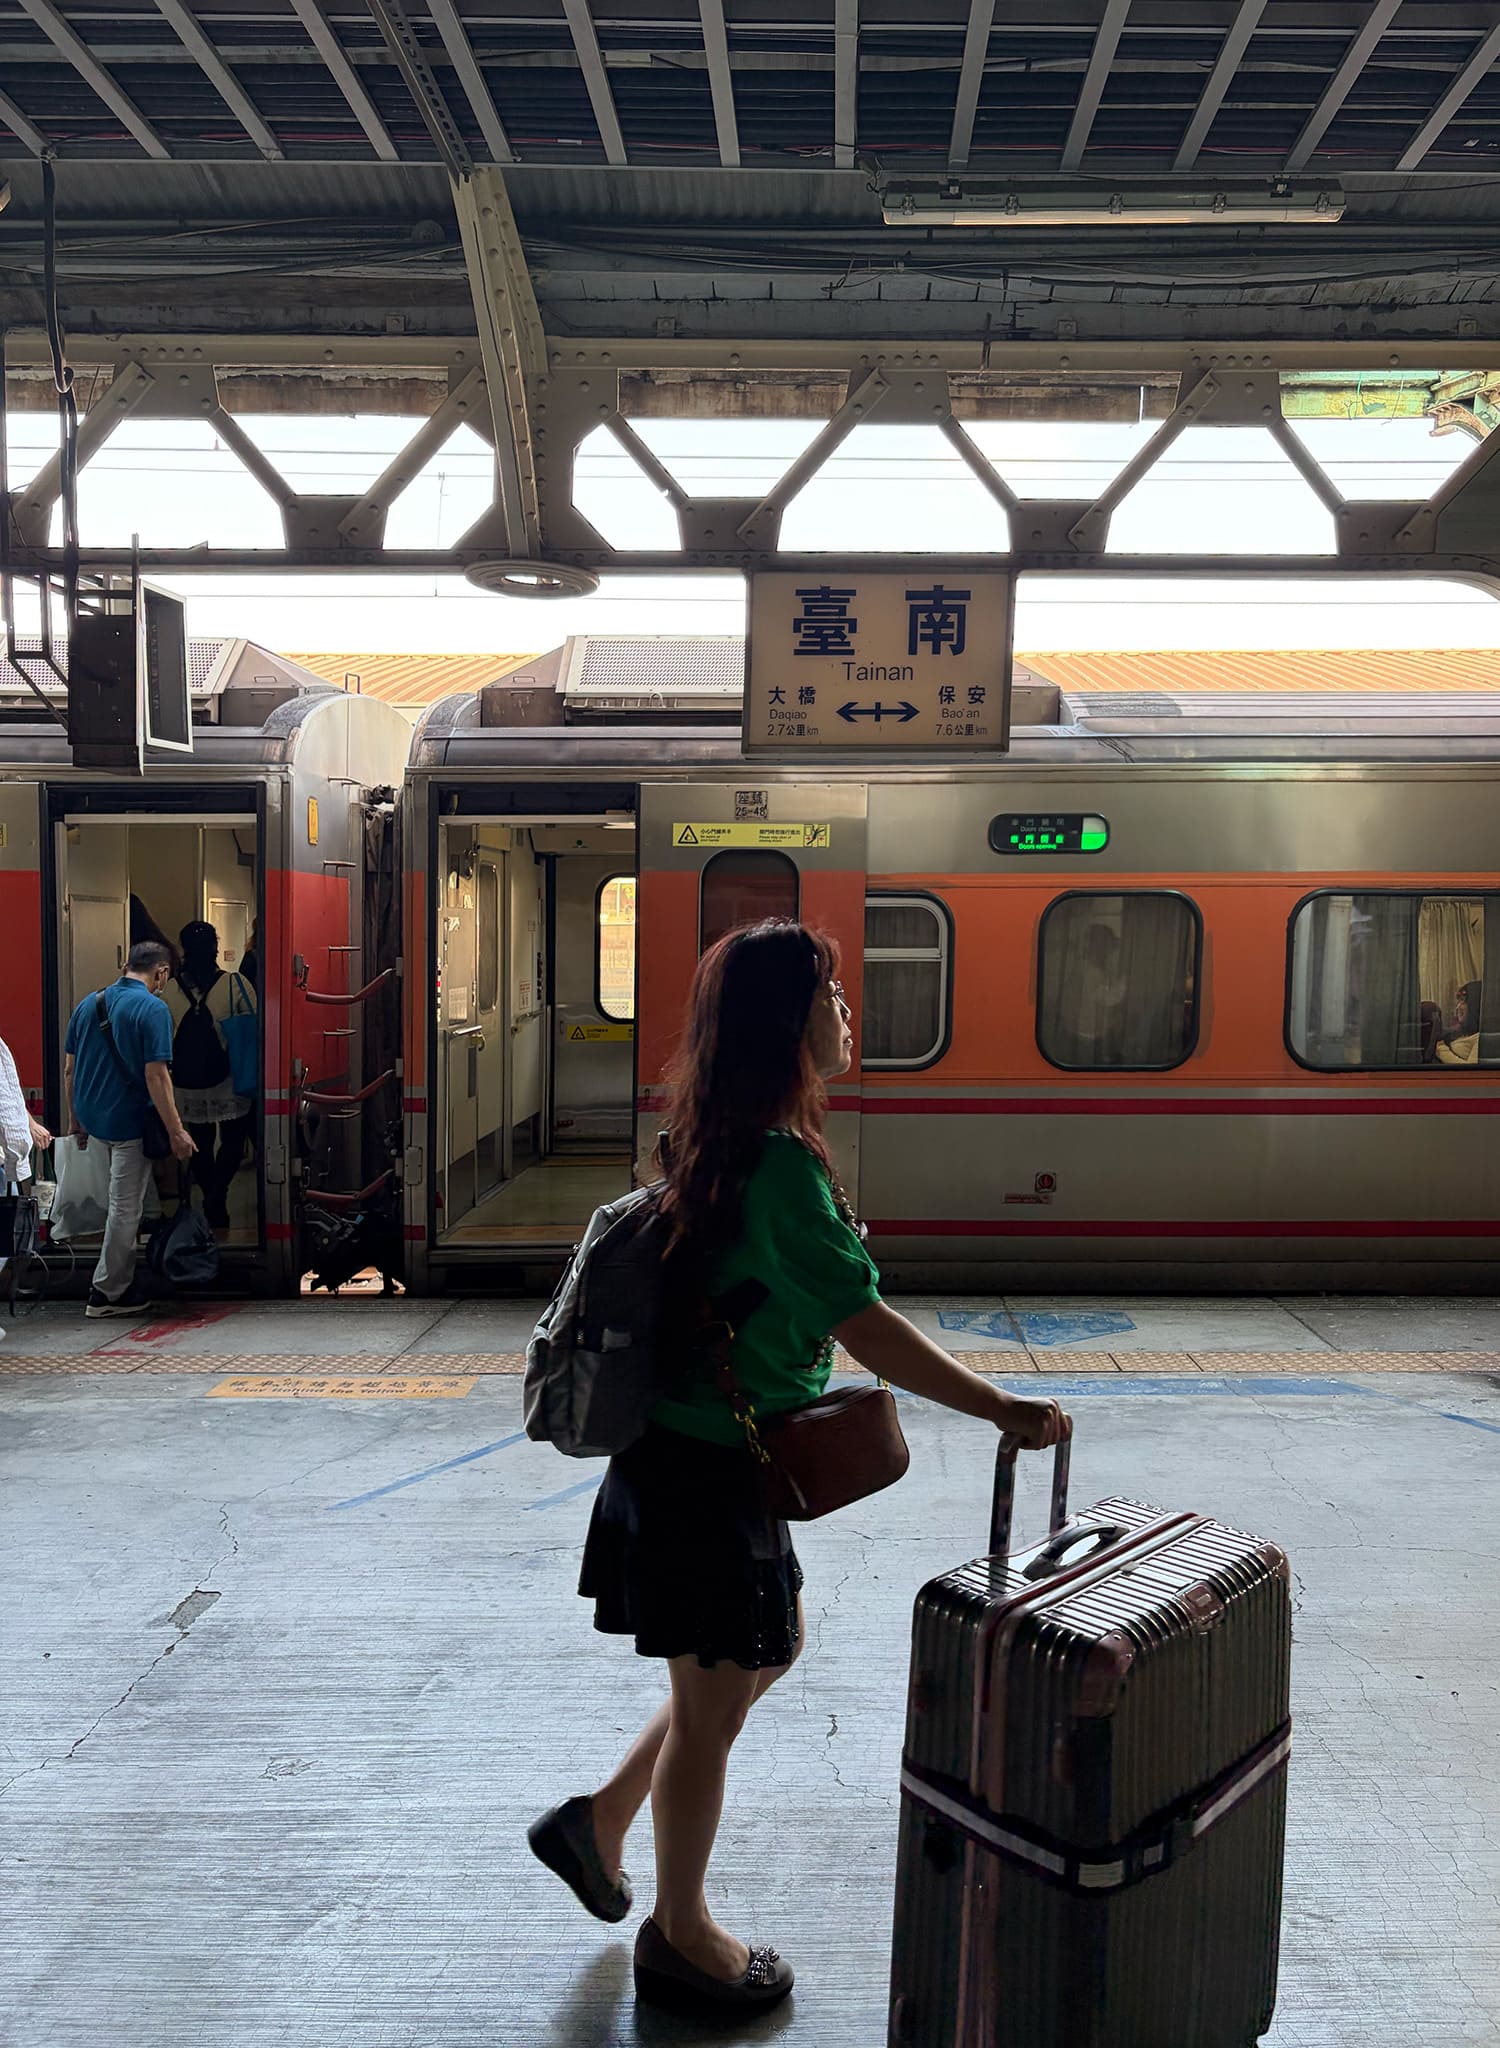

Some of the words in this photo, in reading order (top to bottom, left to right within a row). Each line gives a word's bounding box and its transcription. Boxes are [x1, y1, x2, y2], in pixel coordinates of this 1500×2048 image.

[793, 584, 971, 656] 臺南
[842, 662, 913, 681] Tainan
[768, 686, 816, 705] 大橋
[938, 685, 986, 704] 保安
[769, 709, 807, 721] Daqiao
[942, 708, 980, 719] Bao'an
